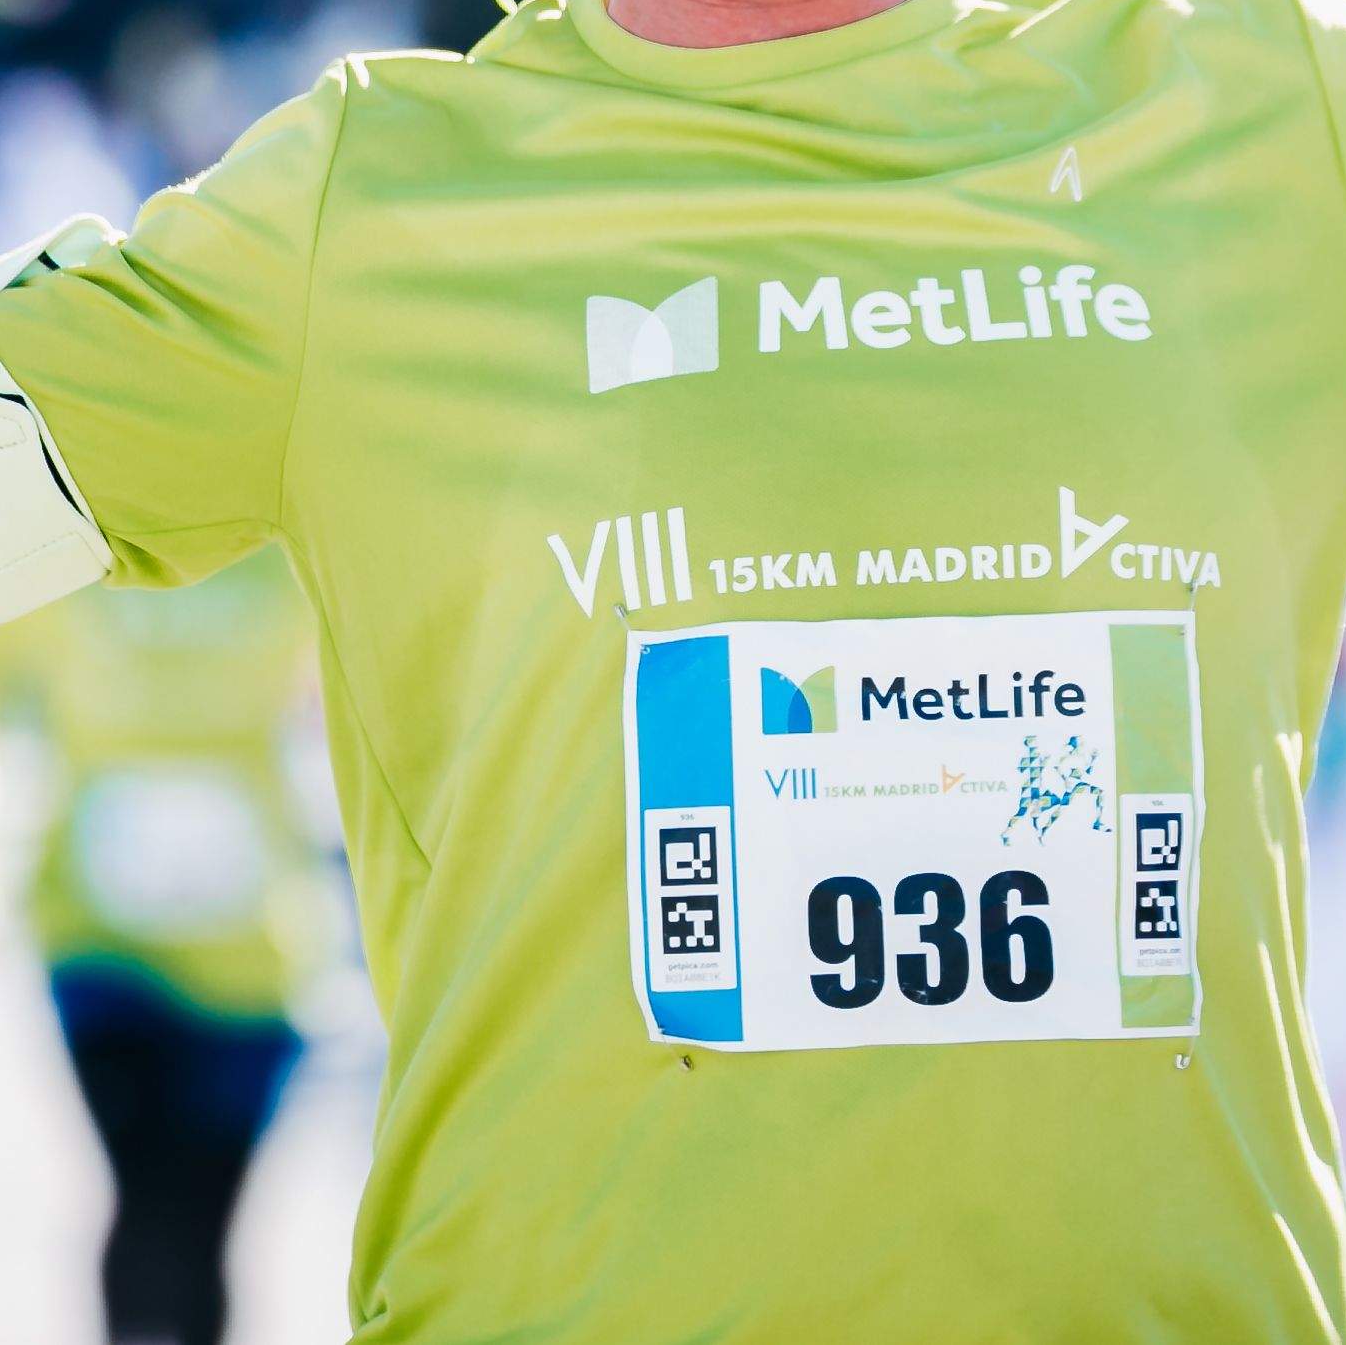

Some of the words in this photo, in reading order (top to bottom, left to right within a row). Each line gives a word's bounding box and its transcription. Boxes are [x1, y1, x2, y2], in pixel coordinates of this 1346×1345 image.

[758, 264, 1153, 353] MetLife
[546, 507, 694, 619] VIII
[709, 551, 837, 596] 15KM
[861, 670, 1085, 721] MetLife
[765, 767, 817, 800] VIII
[824, 785, 867, 798] 15KM
[808, 871, 1054, 1009] 936
